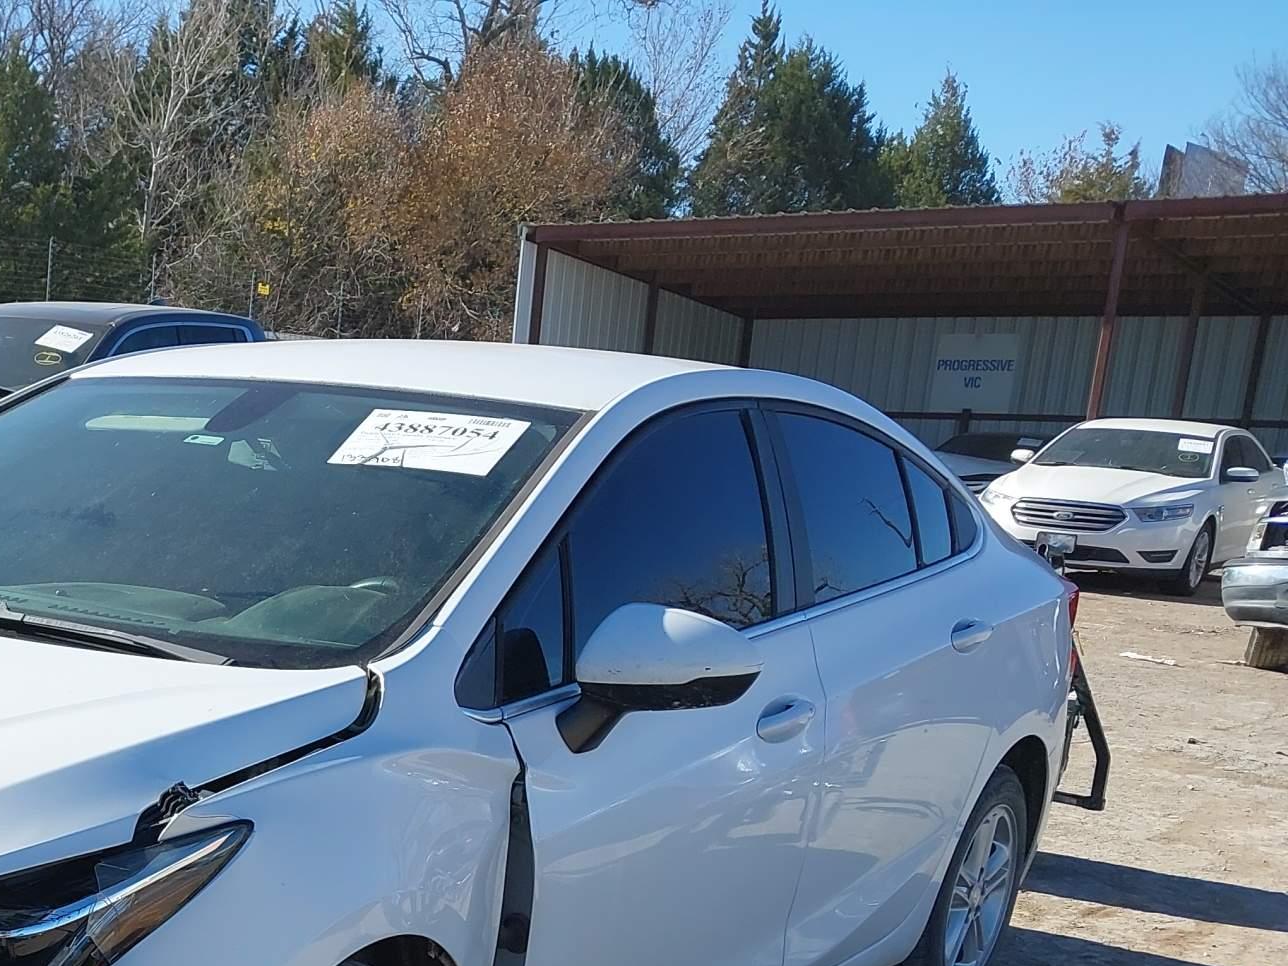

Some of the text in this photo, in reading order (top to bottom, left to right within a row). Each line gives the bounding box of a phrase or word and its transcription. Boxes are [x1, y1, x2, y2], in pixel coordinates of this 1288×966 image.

[936, 359, 1015, 371] PROGRESSIVE
[963, 376, 982, 389] VIC
[374, 422, 500, 441] 43887054
